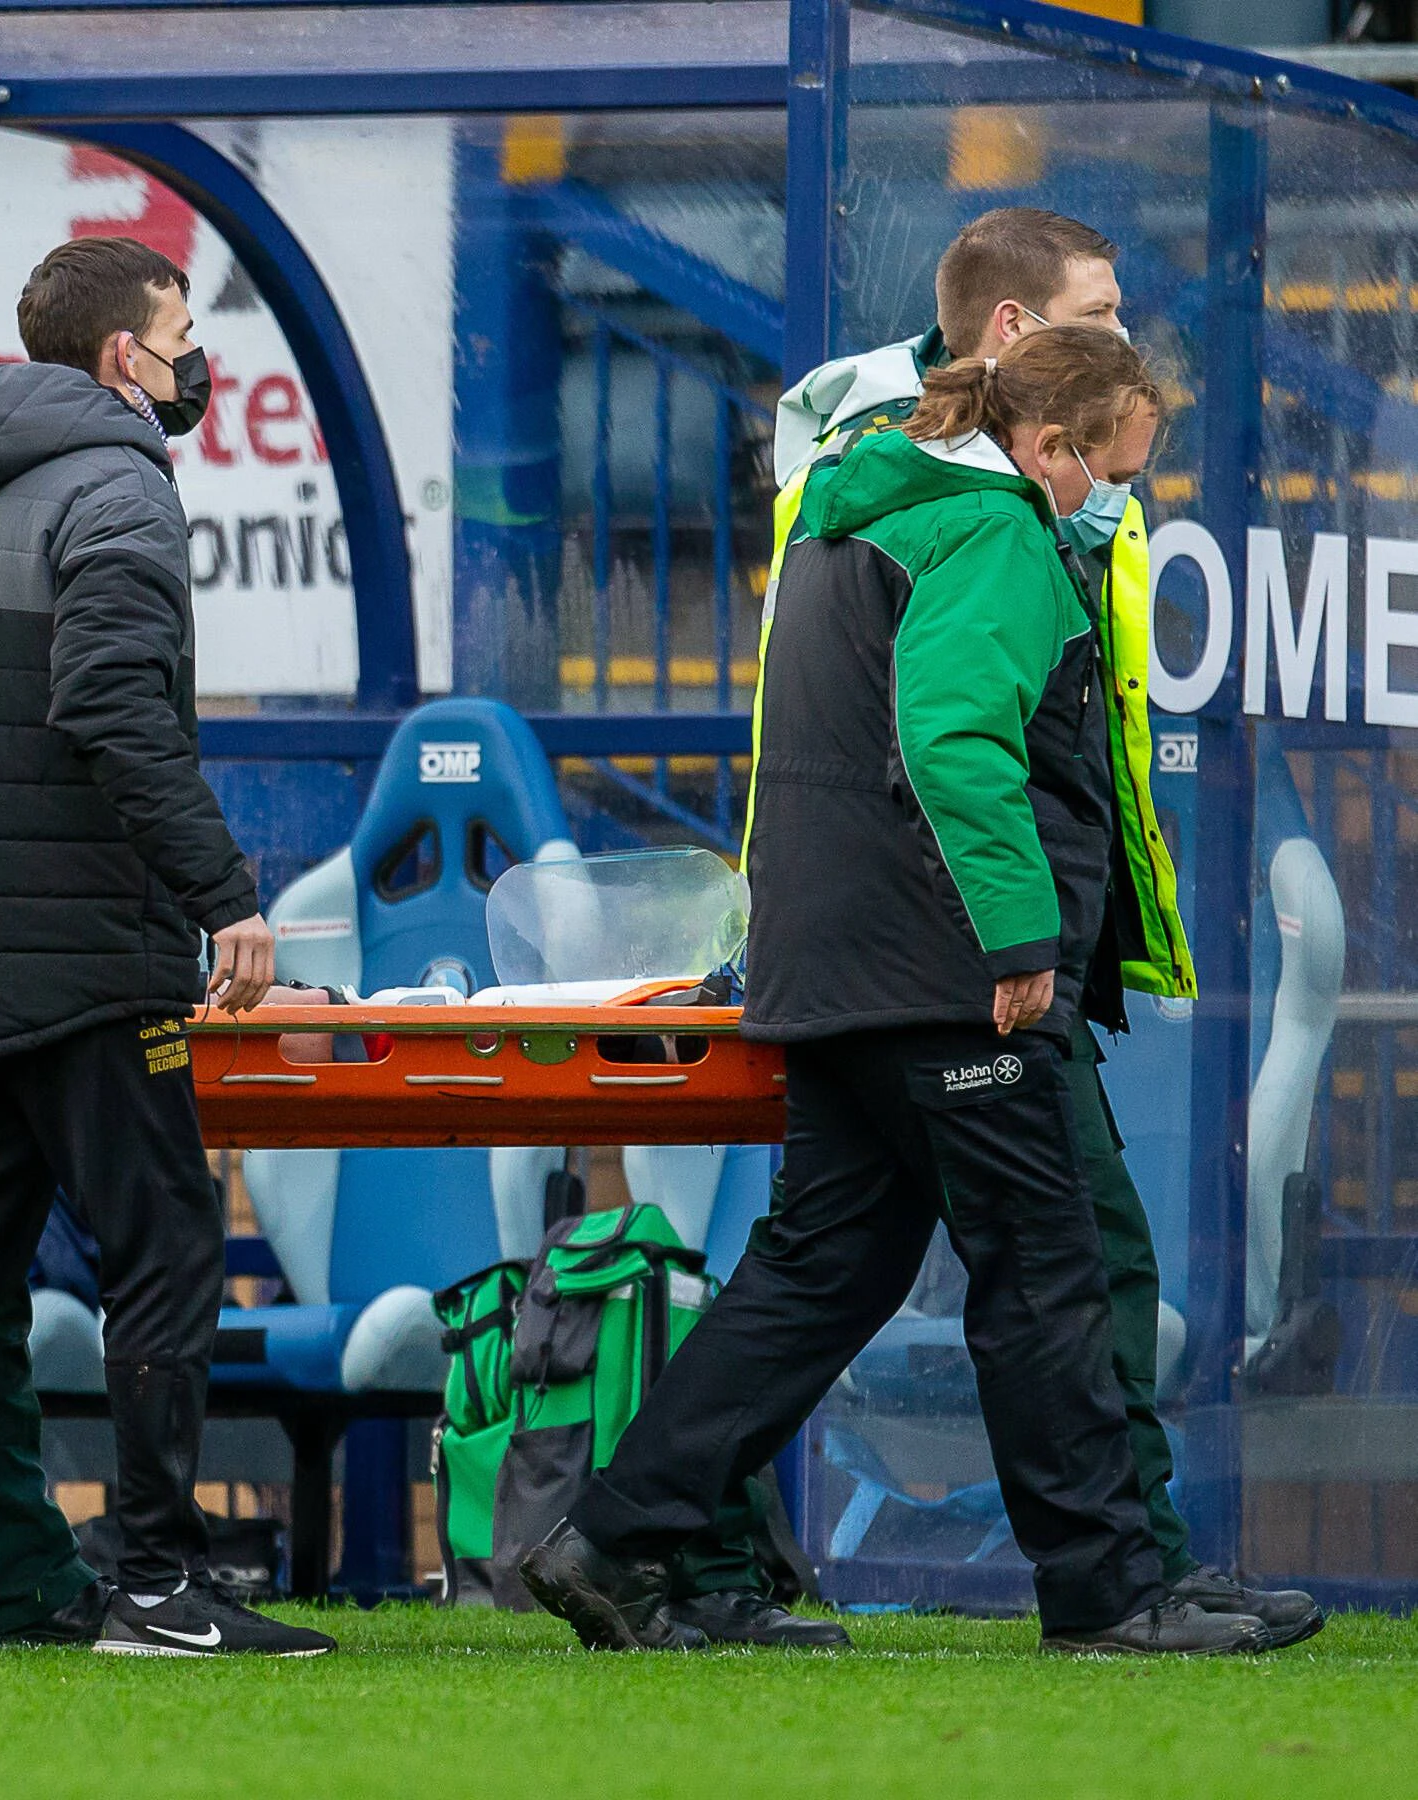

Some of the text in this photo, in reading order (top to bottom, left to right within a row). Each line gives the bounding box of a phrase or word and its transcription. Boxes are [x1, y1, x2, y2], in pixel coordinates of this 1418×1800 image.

[420, 750, 481, 778] OMP
[1158, 739, 1199, 769] OM
[149, 1051, 189, 1075] RECORDS
[943, 1065, 991, 1082] St John
[946, 1077, 992, 1092] Ambulance
